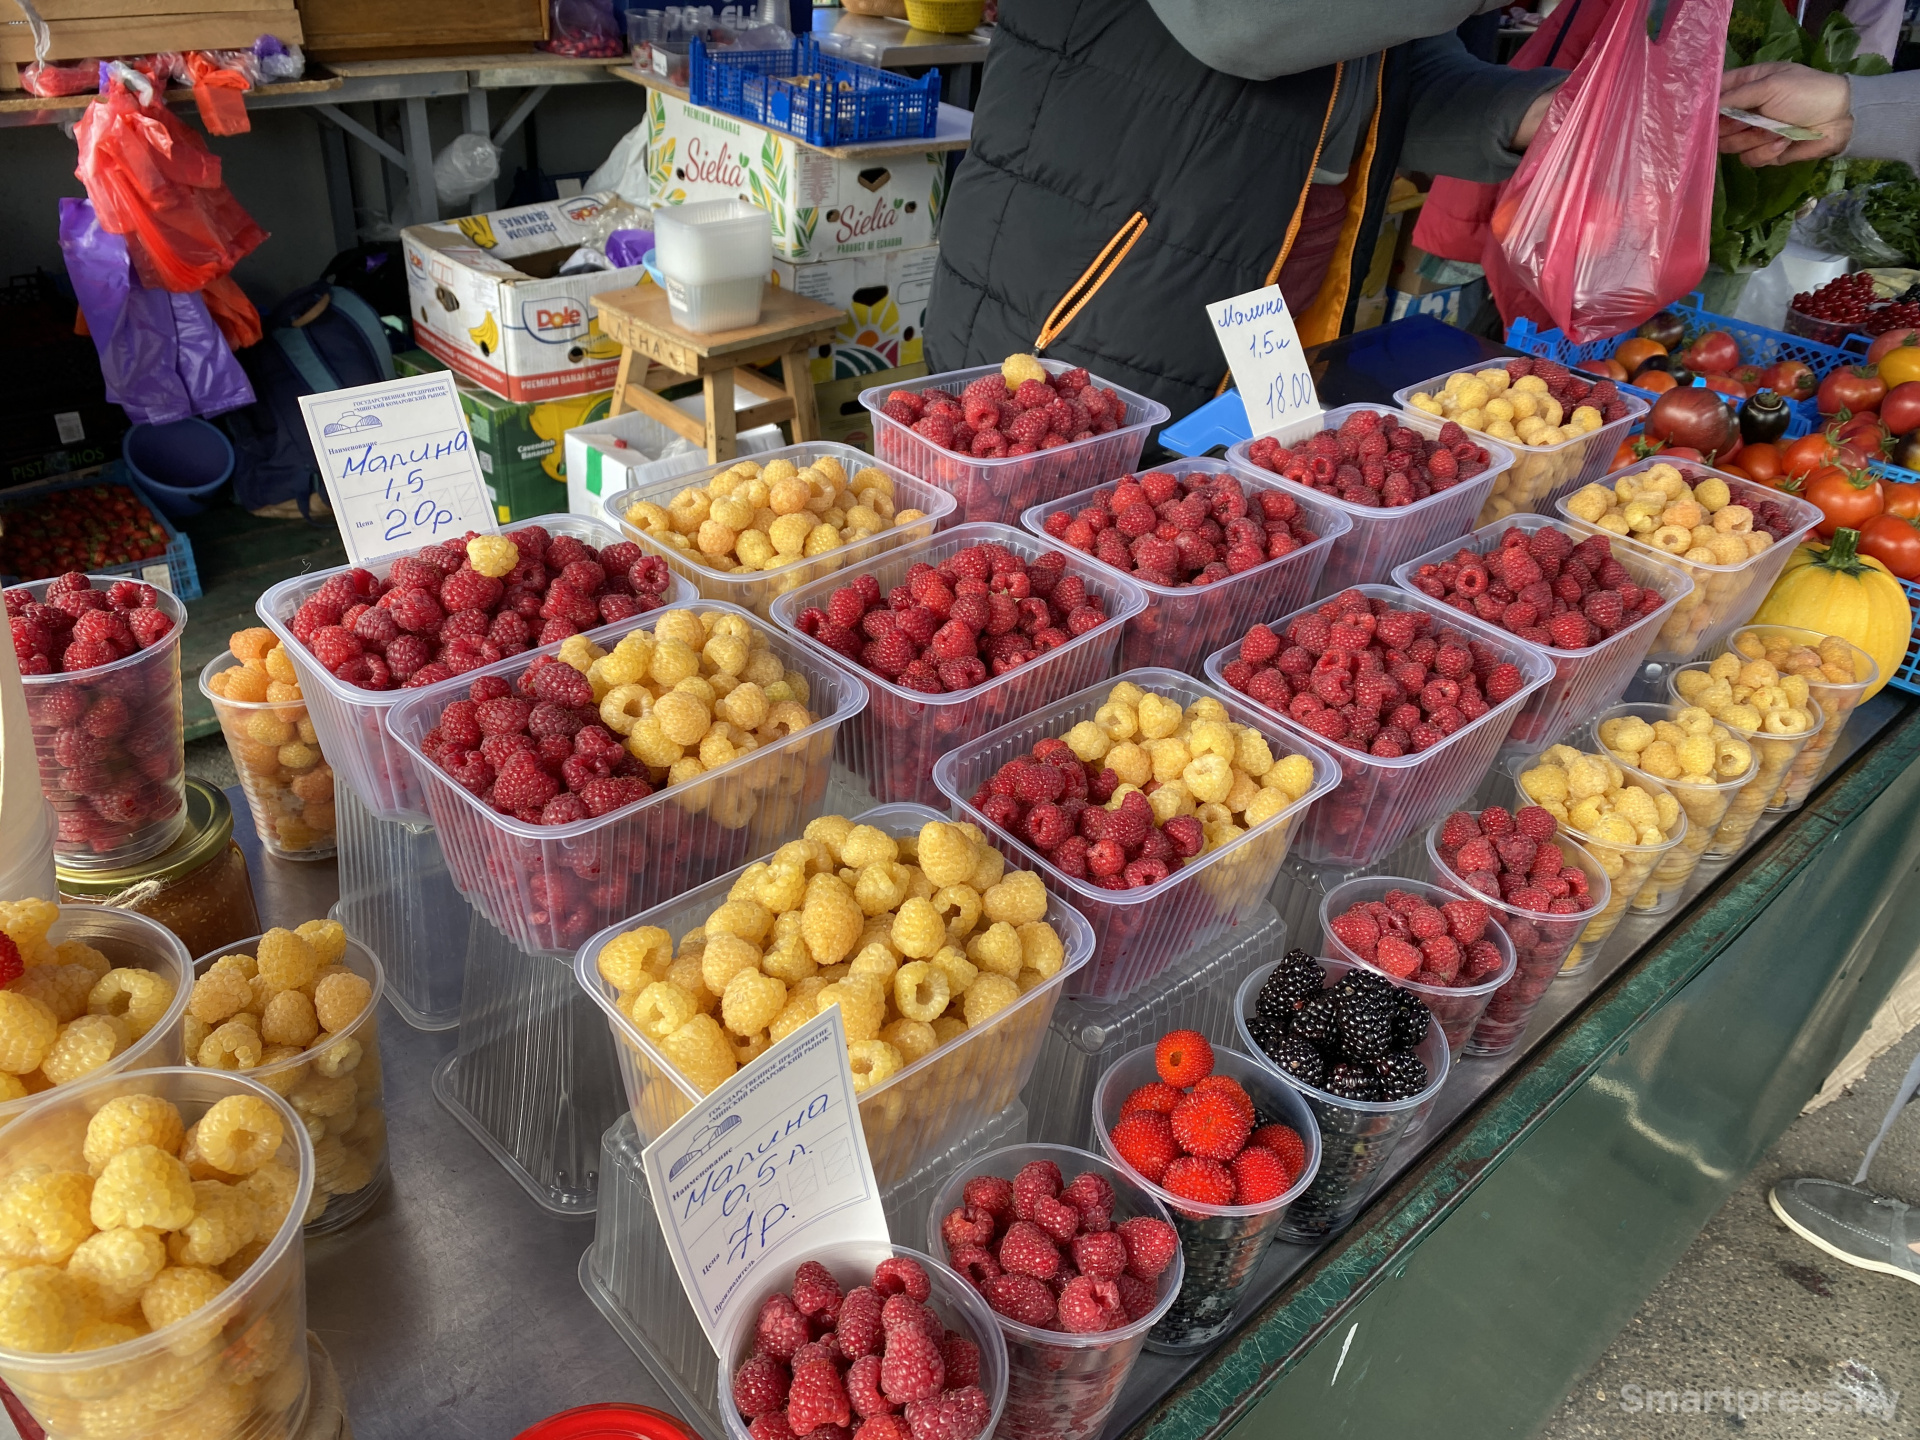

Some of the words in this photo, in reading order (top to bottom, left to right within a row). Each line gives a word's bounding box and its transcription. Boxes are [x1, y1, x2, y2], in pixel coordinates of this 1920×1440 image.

[682, 104, 712, 124] PREMIUM
[712, 114, 741, 136] BANANAS
[684, 137, 745, 187] Sielia
[499, 210, 550, 229] BANANAS
[506, 221, 557, 240] PREMIUM
[836, 196, 899, 244] Sielia
[837, 241, 866, 254] PRODUCT
[867, 240, 875, 250] OF
[536, 307, 581, 329] Dole
[1218, 297, 1284, 328] Малина
[520, 376, 560, 390] PREMIUM
[560, 370, 597, 386] BANANAS
[1266, 372, 1312, 419] 18.00
[353, 392, 406, 407] ГОСУДАРСТВЕННОЕ
[407, 385, 445, 397] ПРЕДПРИЯТИЕ
[328, 440, 378, 455] Наименование
[342, 430, 468, 479] Малина
[517, 439, 556, 454] Cavendish
[521, 447, 554, 460] Bananas
[11, 448, 106, 482] PISTACHIOS
[385, 468, 424, 502] 1,5
[356, 519, 374, 529] Цена
[708, 1063, 778, 1118] ГОСУДАРСТВЕННОЕ
[778, 1027, 829, 1065] ПРЕДПРИЯТИЕ
[749, 1052, 803, 1094] КОМАРОВСКИЙ
[683, 1094, 829, 1219] Малина
[672, 1146, 734, 1201] Наименование
[702, 1252, 721, 1276] Цена
[713, 1257, 756, 1316] Производитель
